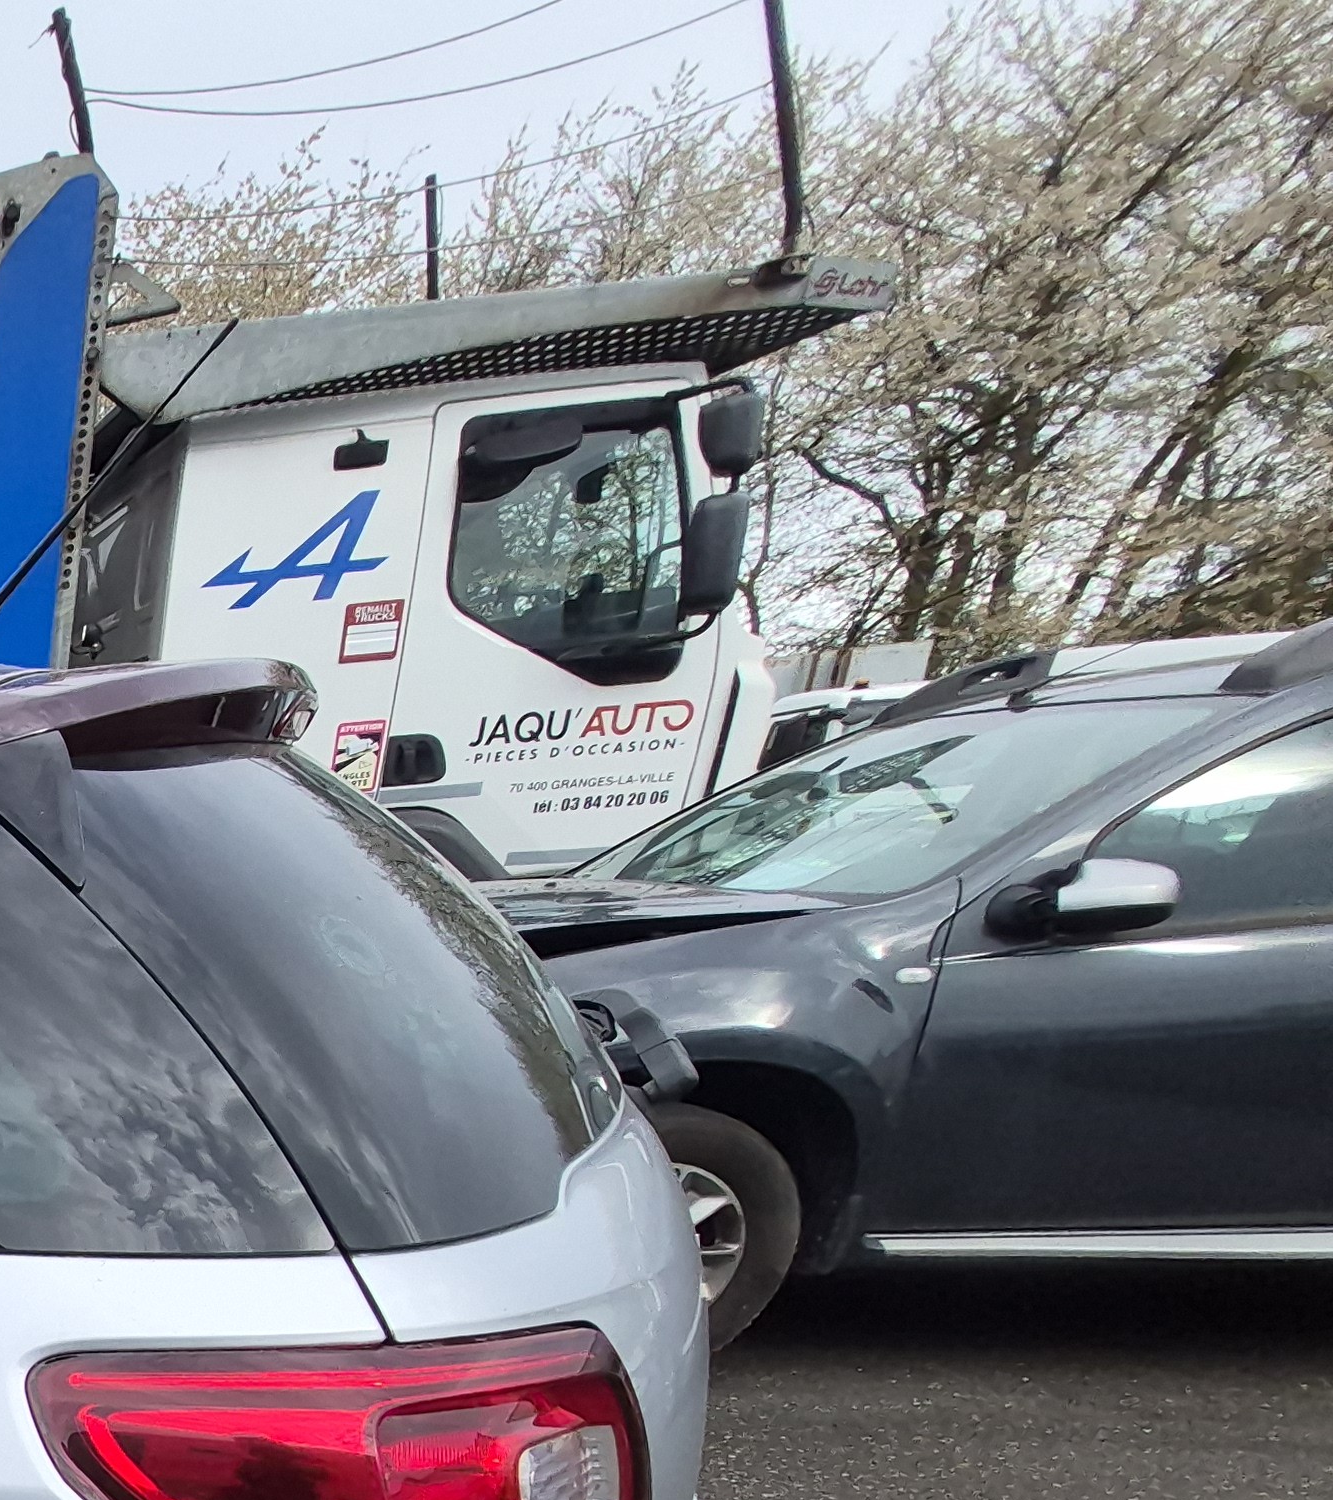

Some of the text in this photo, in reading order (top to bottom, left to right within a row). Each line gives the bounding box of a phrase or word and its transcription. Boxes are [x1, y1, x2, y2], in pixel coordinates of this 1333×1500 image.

[355, 611, 396, 623] TRUCKS
[468, 699, 695, 747] JAQU'AUTO
[339, 771, 371, 780] NGLES
[550, 771, 675, 790] GRANGES-LA-VILLE
[560, 798, 579, 811] 03
[583, 796, 601, 810] 84
[605, 794, 624, 808] 20
[628, 792, 646, 806] 20
[649, 790, 669, 804] 06
